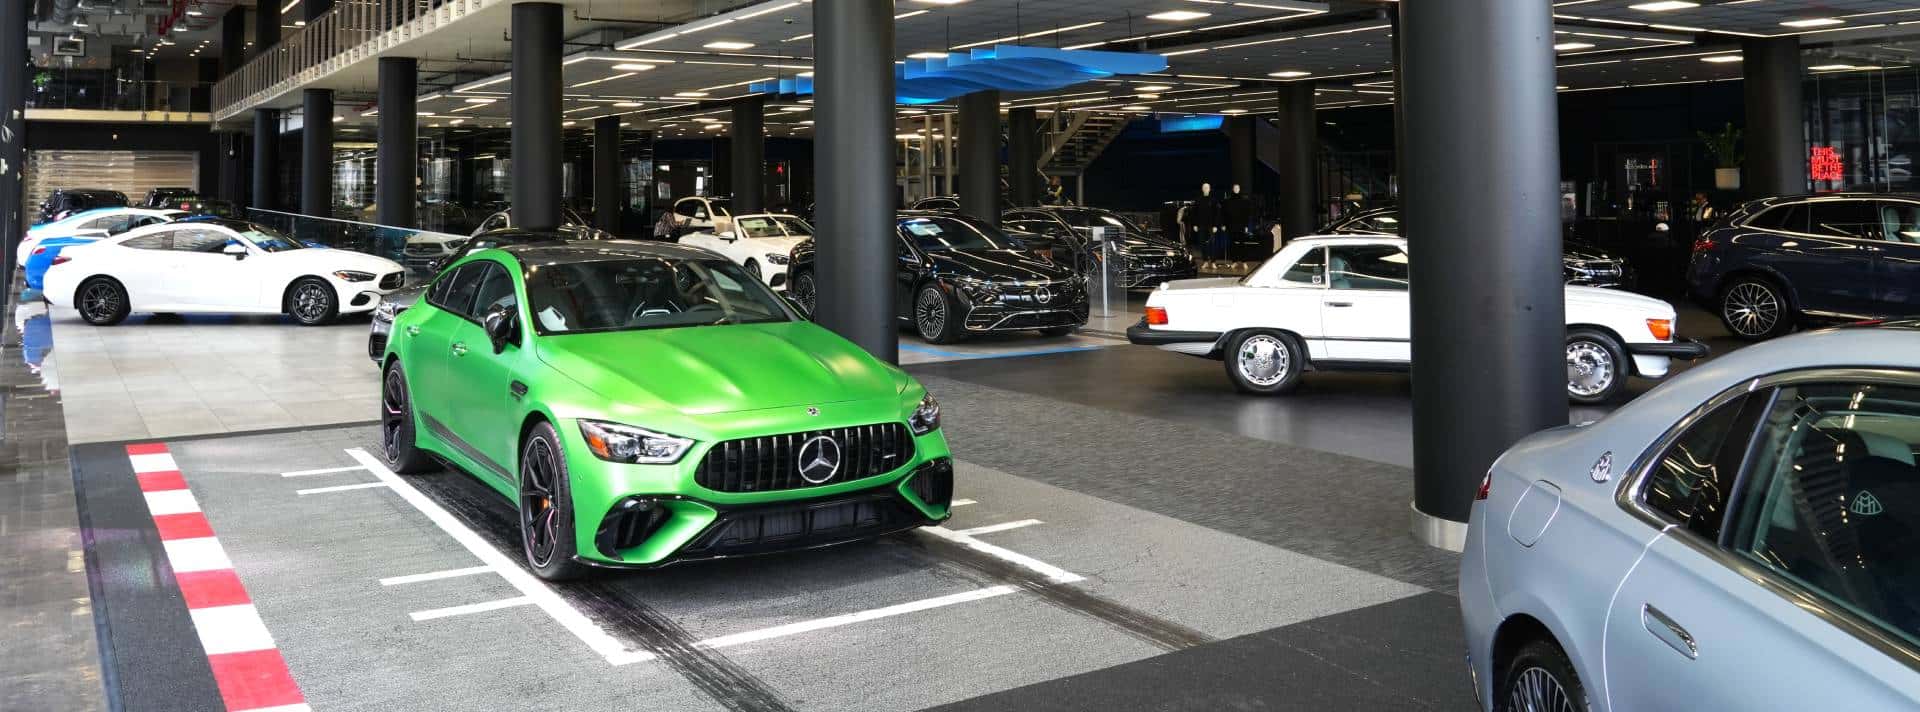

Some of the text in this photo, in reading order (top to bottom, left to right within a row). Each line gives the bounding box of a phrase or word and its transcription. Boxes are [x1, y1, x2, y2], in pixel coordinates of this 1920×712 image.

[1812, 146, 1834, 156] THIS
[1811, 154, 1841, 164] MUST
[1811, 162, 1843, 172] BE THE
[1811, 171, 1843, 180] PLACE
